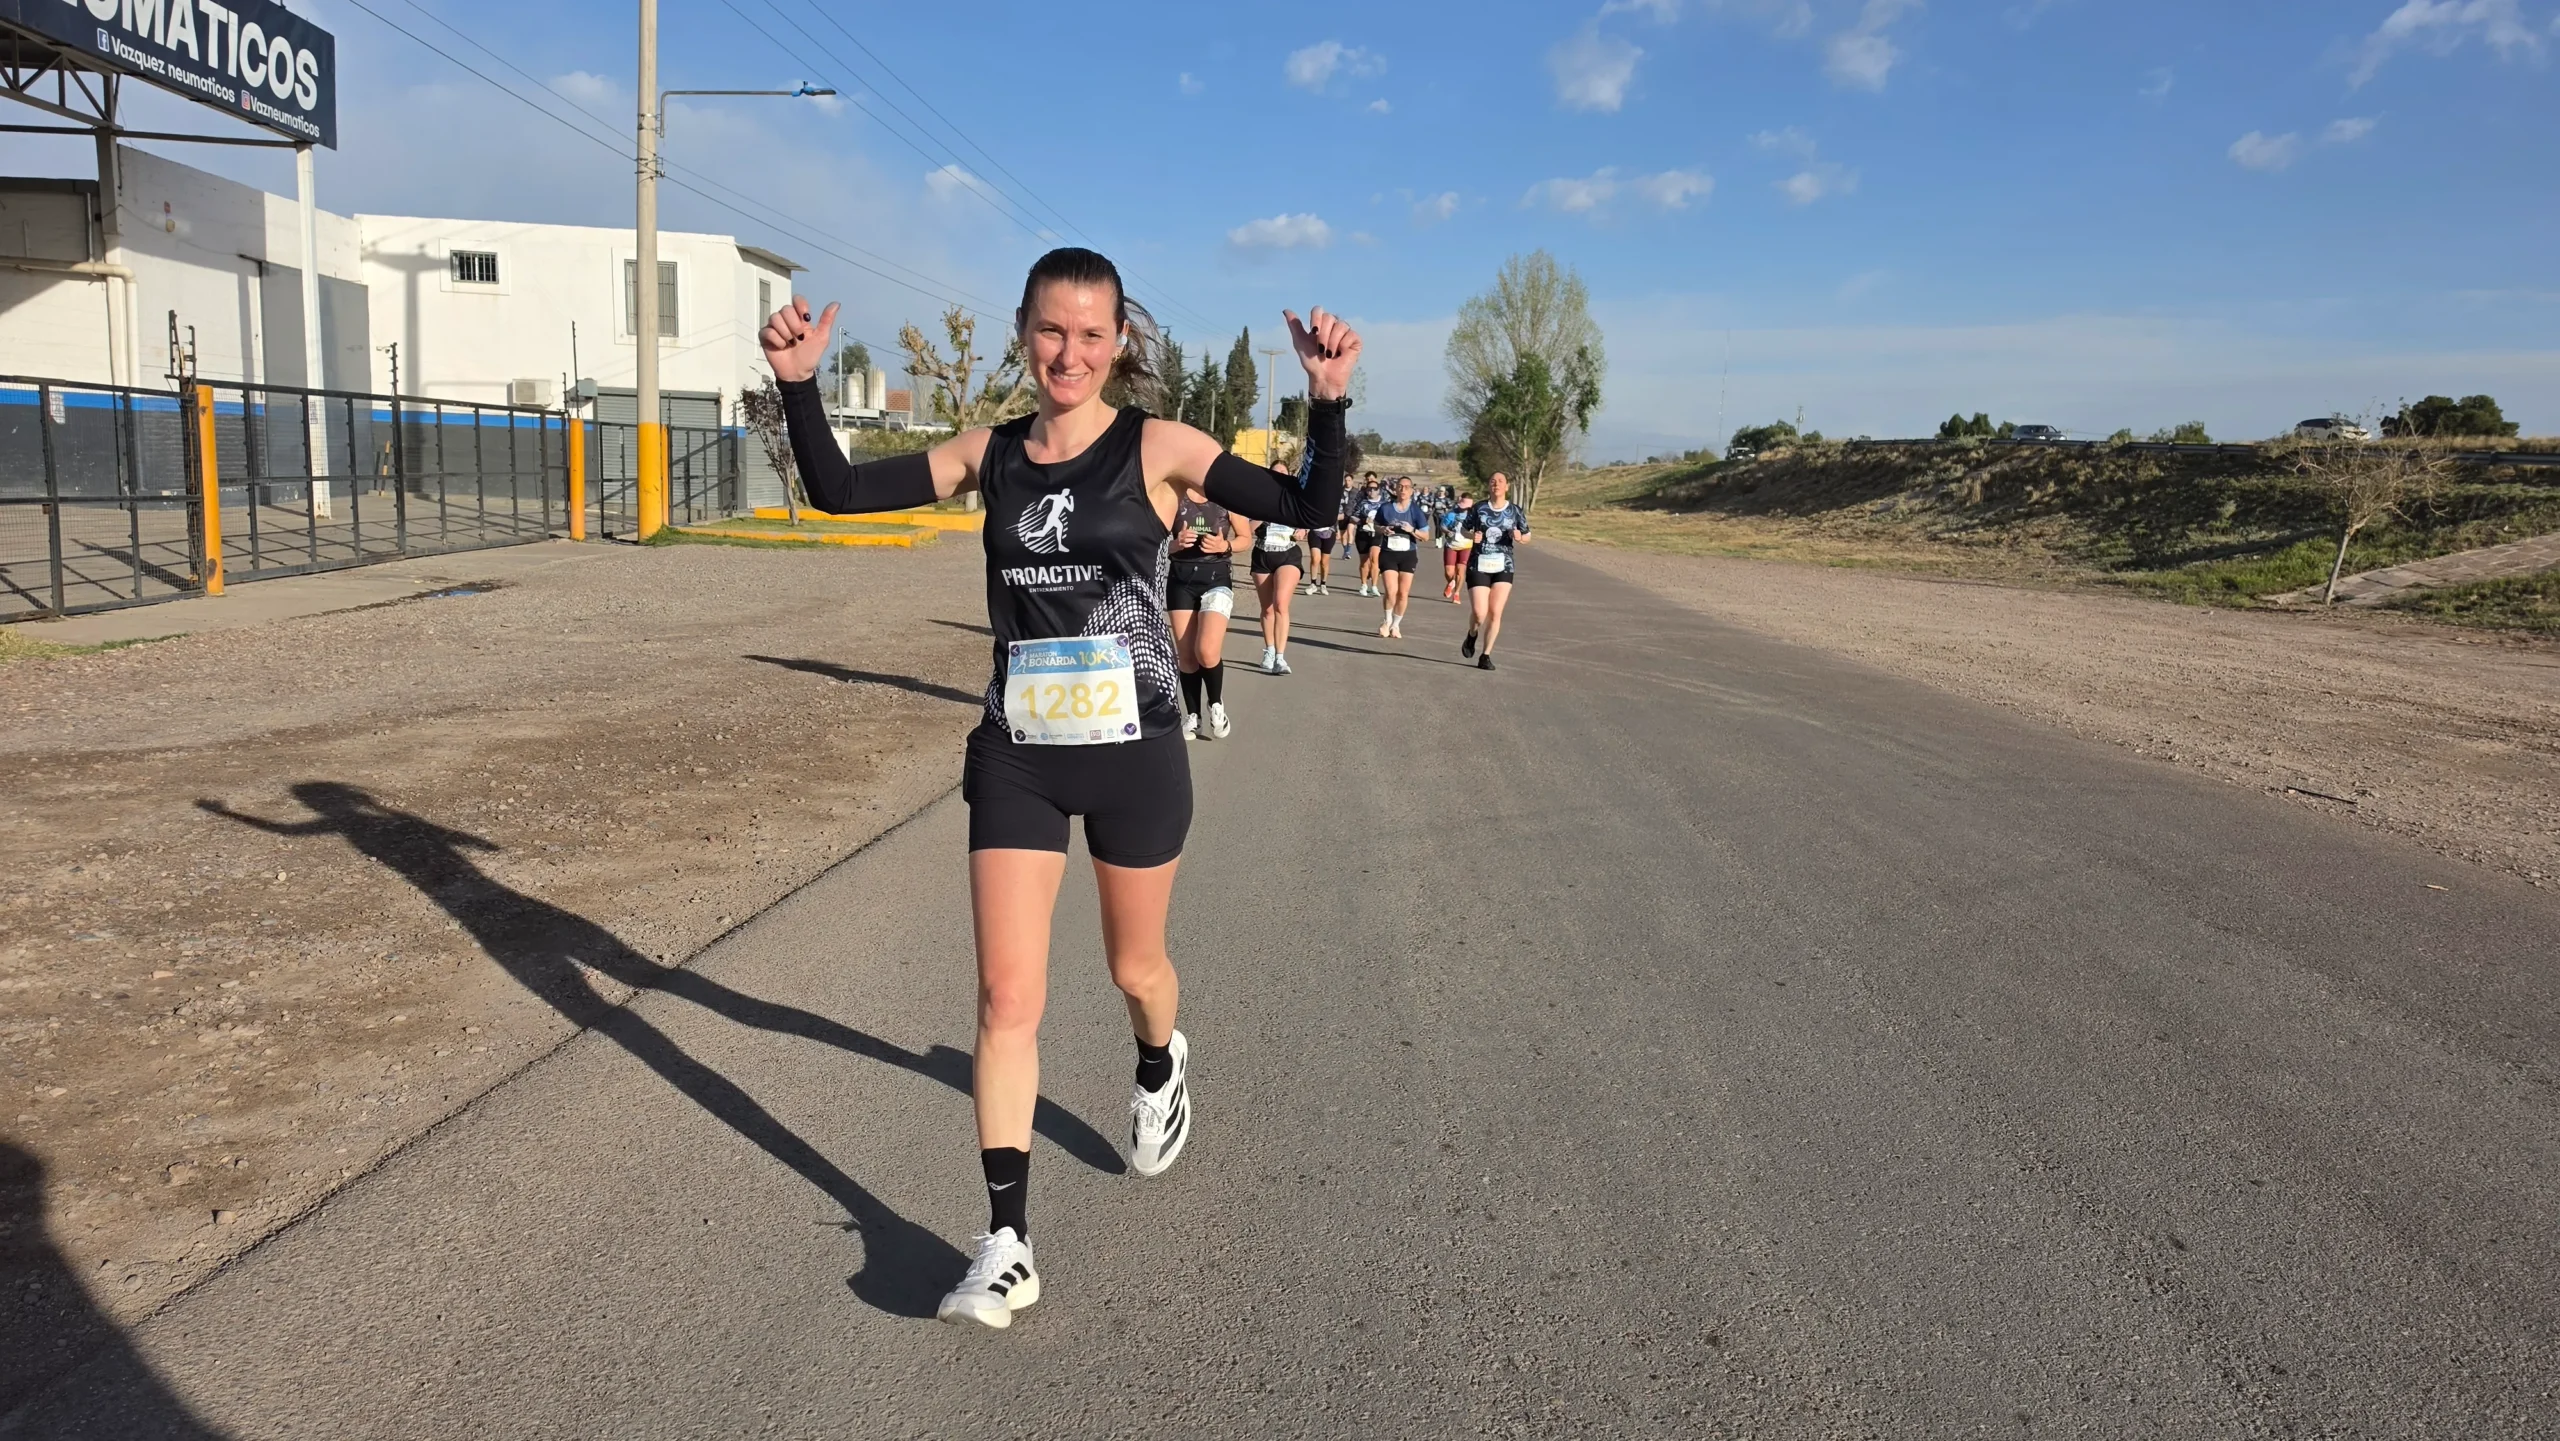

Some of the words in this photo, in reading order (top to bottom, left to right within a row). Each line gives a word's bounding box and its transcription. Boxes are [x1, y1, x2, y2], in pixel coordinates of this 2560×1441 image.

[111, 35, 166, 74] Vazquez
[168, 63, 235, 103] neumaticos
[250, 95, 320, 137] Vazneumaticos
[1001, 565, 1104, 586] PROACTIVE
[1028, 655, 1077, 668] BONARDA
[1079, 649, 1110, 666] 10K
[1020, 680, 1121, 720] 1282
